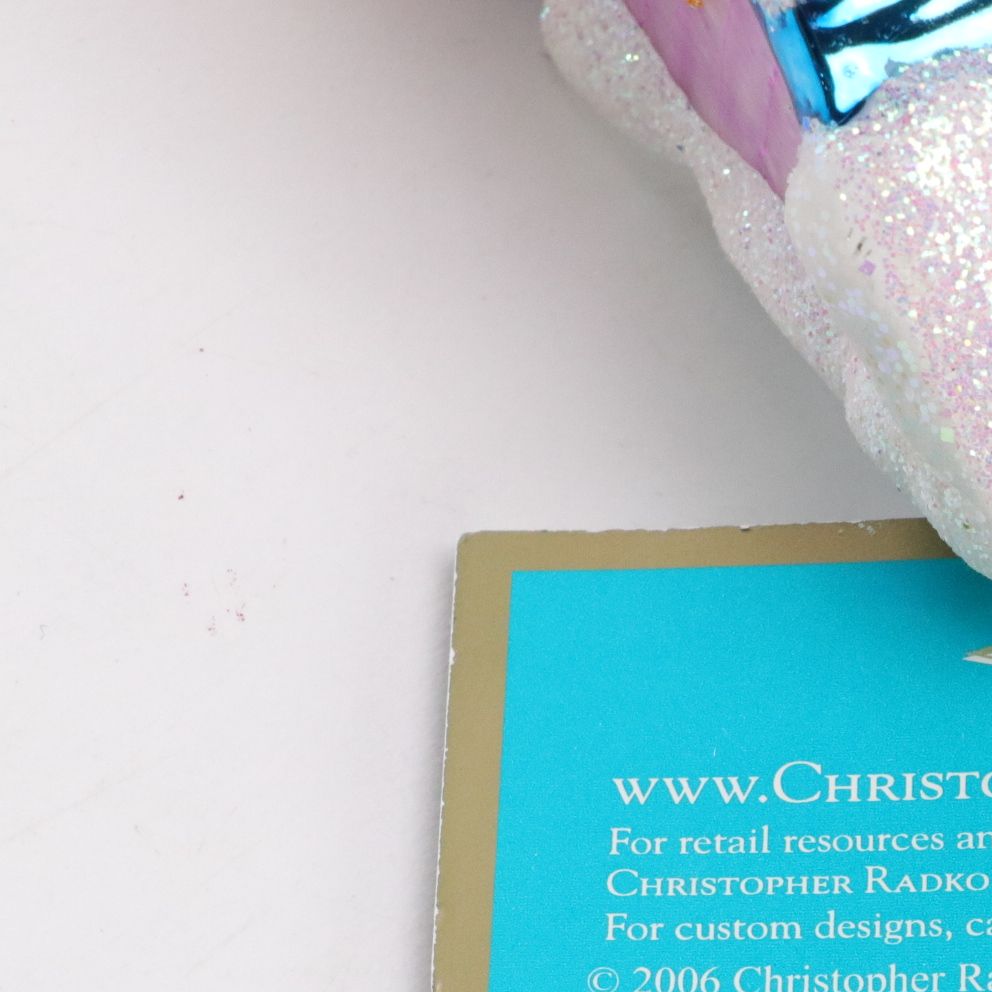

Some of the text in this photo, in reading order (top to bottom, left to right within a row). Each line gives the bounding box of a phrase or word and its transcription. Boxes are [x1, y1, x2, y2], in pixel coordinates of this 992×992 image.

[609, 827, 668, 856] For
[679, 824, 770, 855] retail
[783, 833, 945, 854] resources
[605, 912, 665, 941] For
[674, 919, 803, 941] custom
[814, 909, 953, 945] designs,
